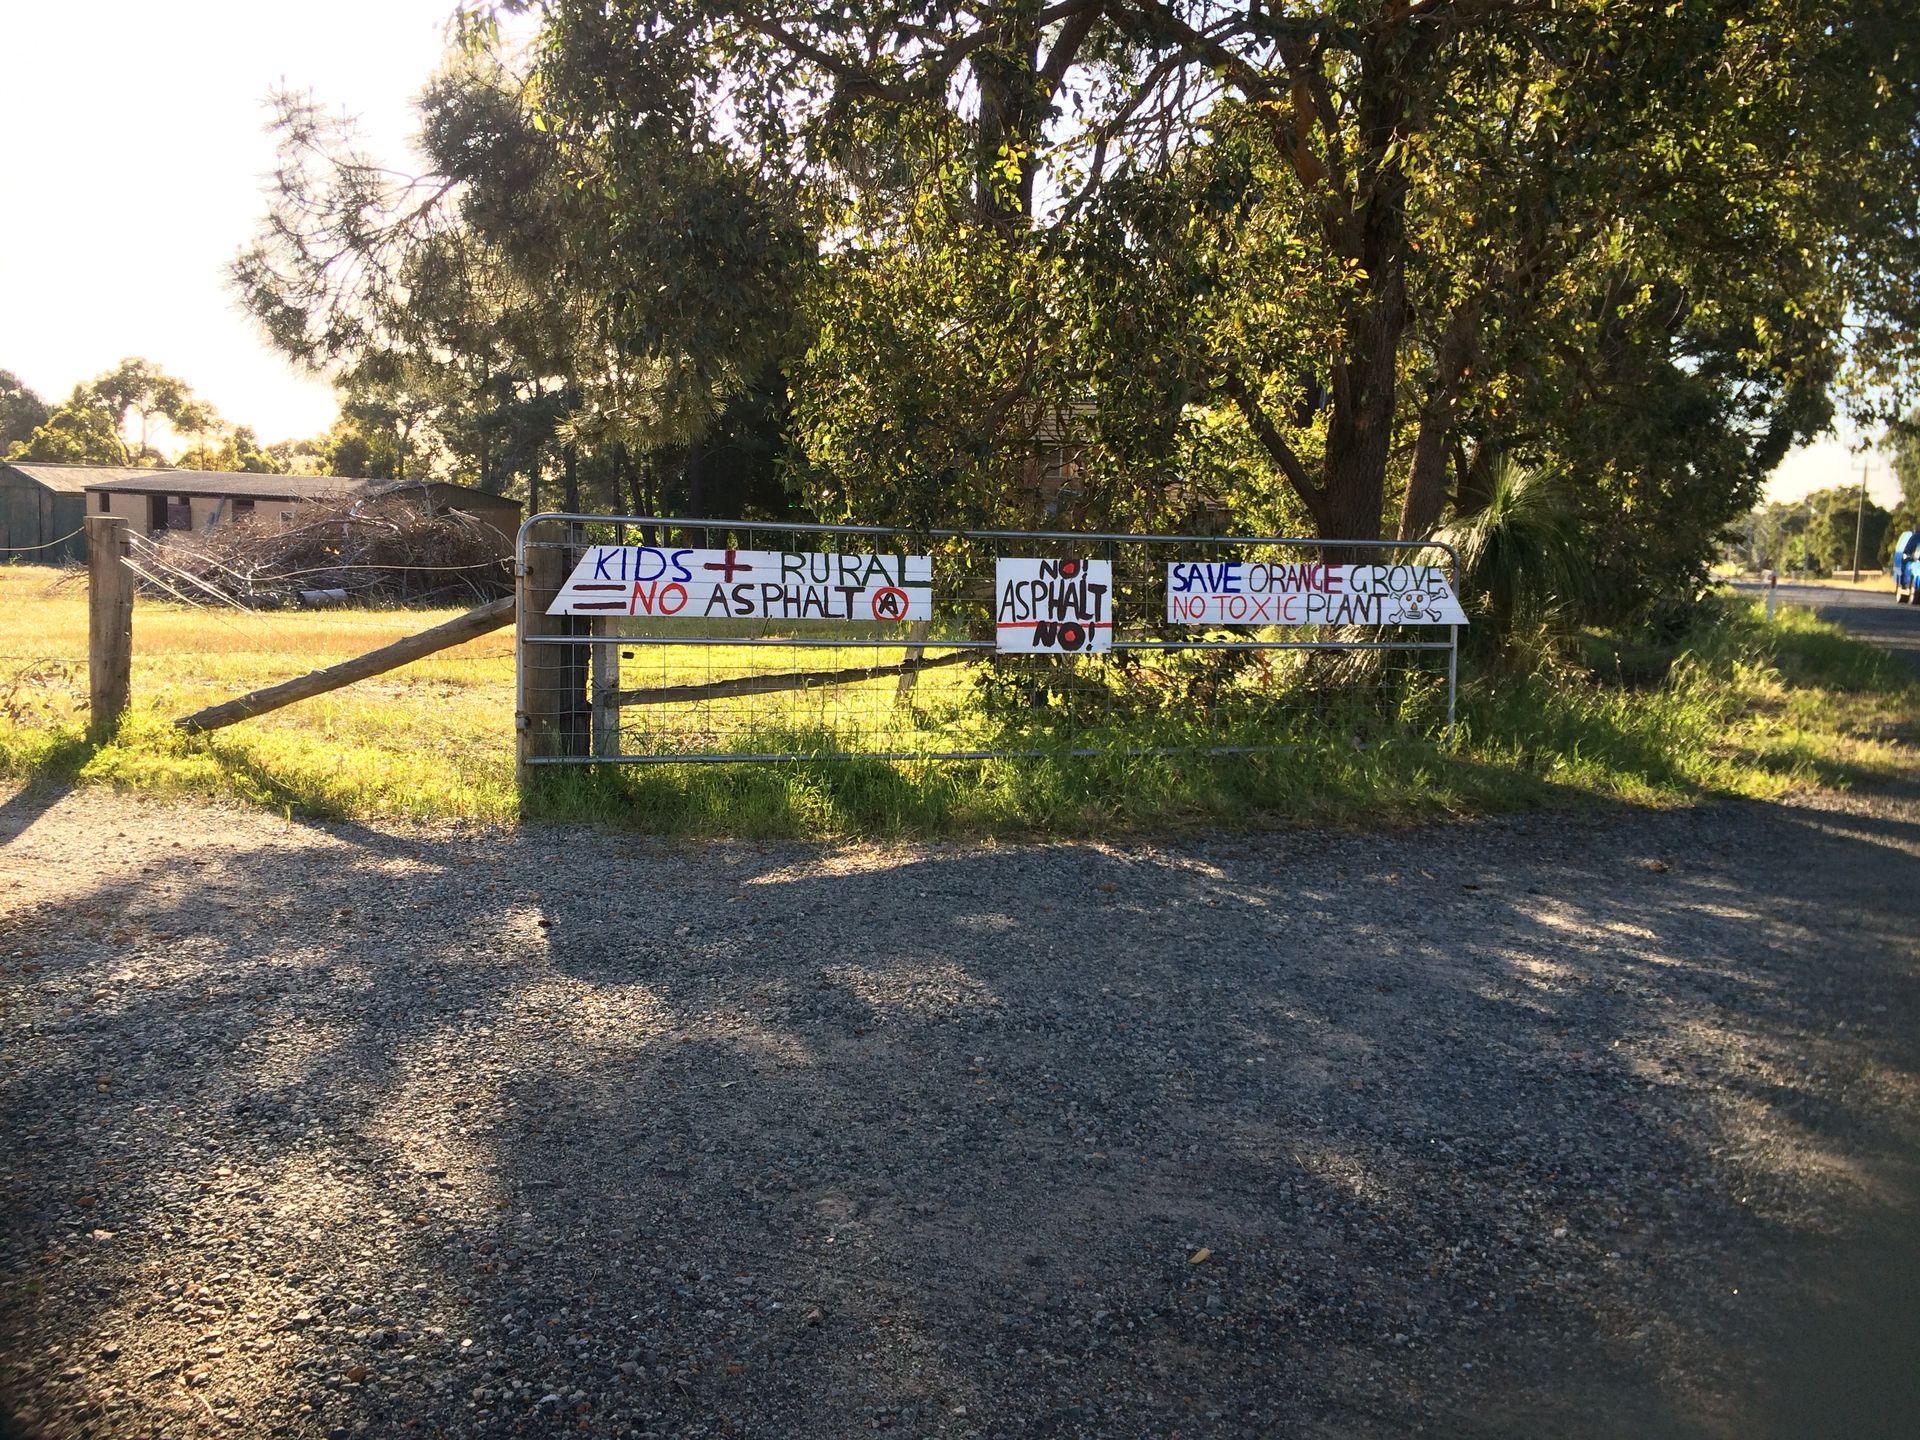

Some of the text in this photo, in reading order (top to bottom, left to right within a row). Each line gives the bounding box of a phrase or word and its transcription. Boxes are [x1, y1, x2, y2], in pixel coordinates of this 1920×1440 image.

[593, 547, 694, 583] KIDS
[781, 551, 931, 588] RURAL
[1039, 559, 1089, 580] NO!
[1172, 562, 1443, 594] SAVE ORANGE GROVE
[629, 580, 689, 616] NO
[704, 583, 866, 619] ASPHALT
[998, 579, 1108, 622] ASPHALT
[1173, 593, 1389, 625] NO TOXIC PLANT
[1032, 620, 1096, 652] NO!
